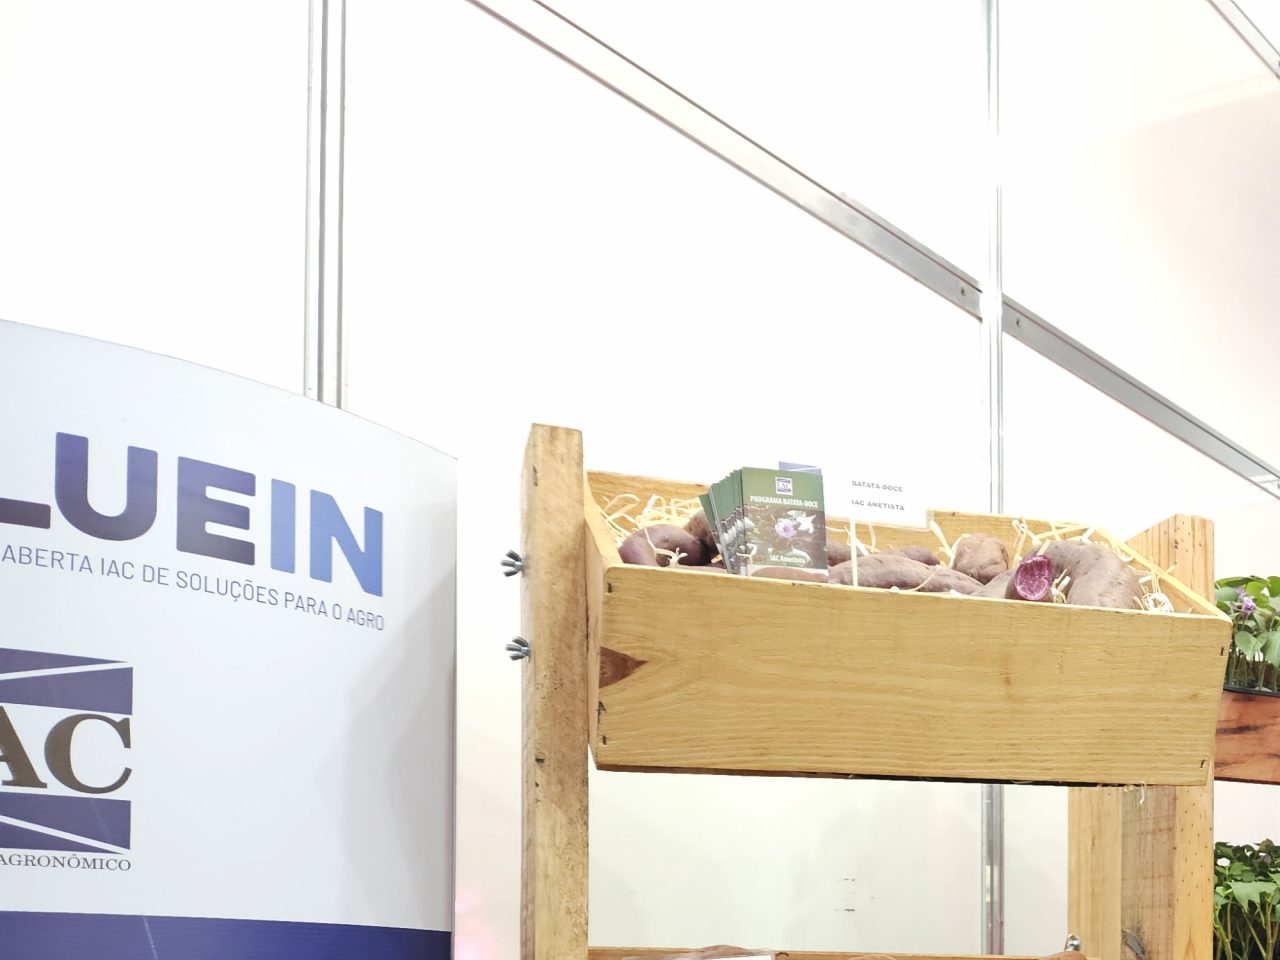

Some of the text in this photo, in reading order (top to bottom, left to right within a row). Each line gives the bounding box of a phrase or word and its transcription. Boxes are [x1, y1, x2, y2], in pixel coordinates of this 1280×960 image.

[1, 544, 385, 631] ABERTA IAC DE SOLUÇÕES PARA O AGRO
